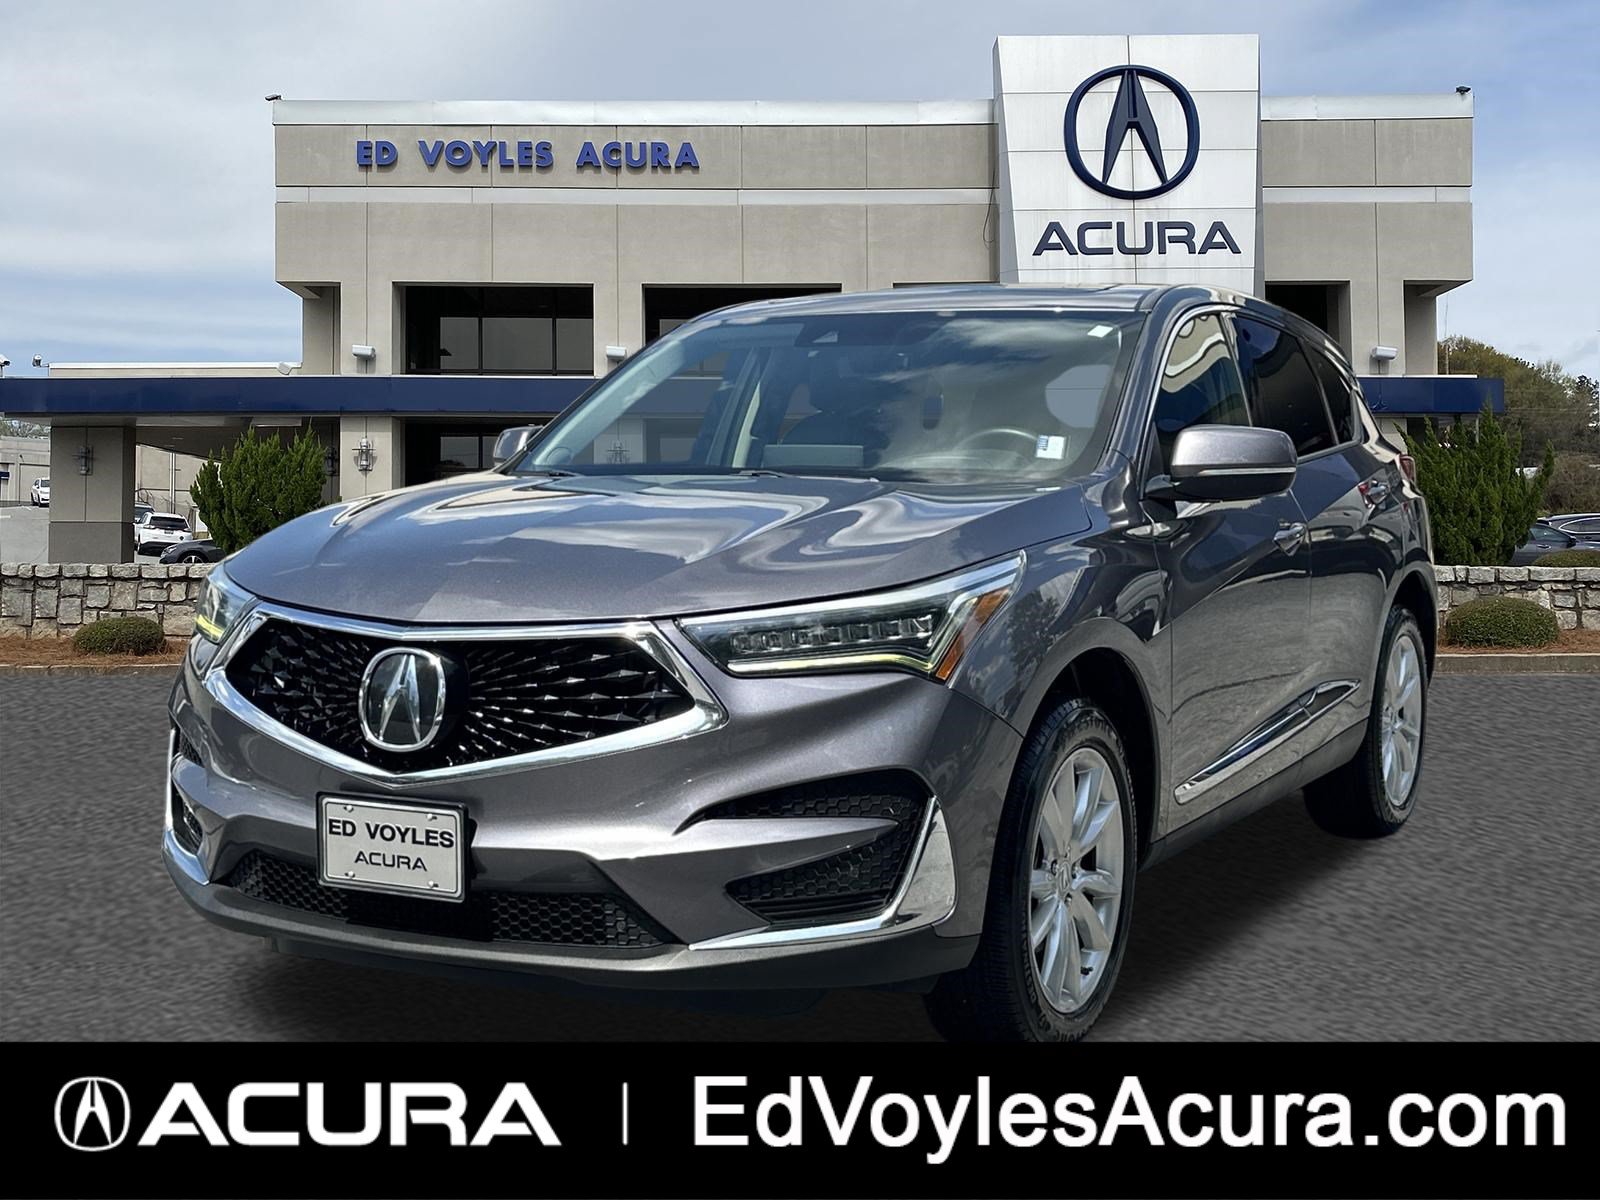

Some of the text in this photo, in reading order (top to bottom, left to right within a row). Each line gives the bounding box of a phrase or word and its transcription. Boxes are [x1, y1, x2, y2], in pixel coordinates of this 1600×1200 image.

[356, 139, 700, 170] ED VOYLES ACURA
[1032, 221, 1241, 256] ACURA
[328, 818, 454, 848] ED VOYLES
[354, 850, 428, 872] ACURA
